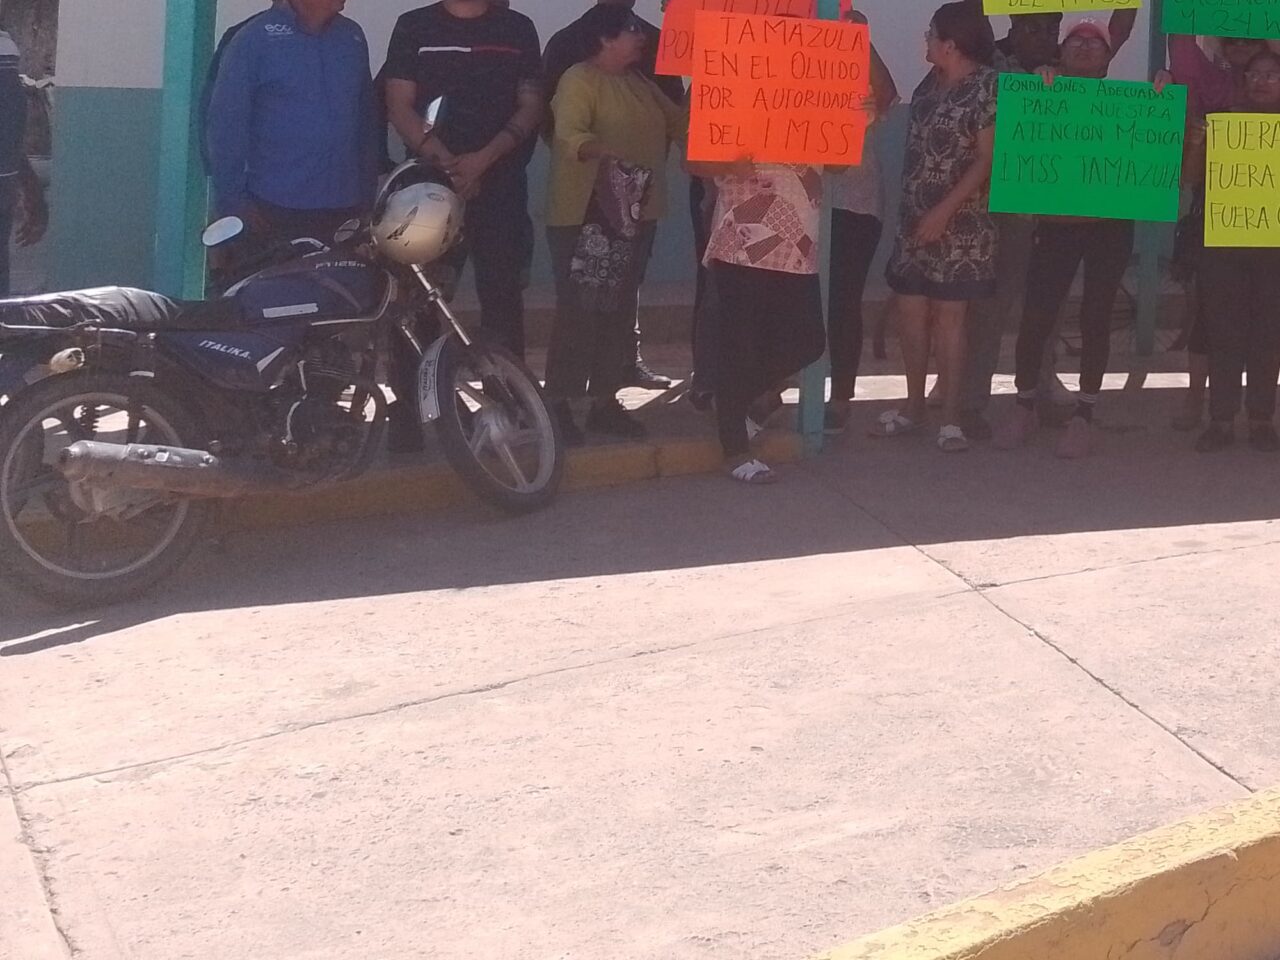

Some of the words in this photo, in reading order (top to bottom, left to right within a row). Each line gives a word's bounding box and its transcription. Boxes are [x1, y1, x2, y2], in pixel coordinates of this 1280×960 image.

[720, 16, 864, 52] TAMAZULA
[1212, 9, 1251, 36] 24
[704, 49, 738, 77] EN
[750, 55, 777, 79] EL
[791, 51, 860, 81] OLVIDO
[698, 84, 735, 110] POR
[752, 87, 867, 111] AUTORIDADES
[1023, 97, 1069, 115] PARA
[1091, 102, 1172, 121] NUESTRA
[709, 122, 746, 146] DEL
[763, 118, 854, 156] IMSS
[1012, 121, 1103, 141] ATENCION
[1116, 120, 1182, 150] MEDICA
[1000, 152, 1063, 184] IMSS
[1078, 155, 1180, 190] TAMAZULA
[1208, 161, 1276, 190] FUERA
[1209, 202, 1270, 231] FUERA
[199, 339, 251, 360] ITALIKA
